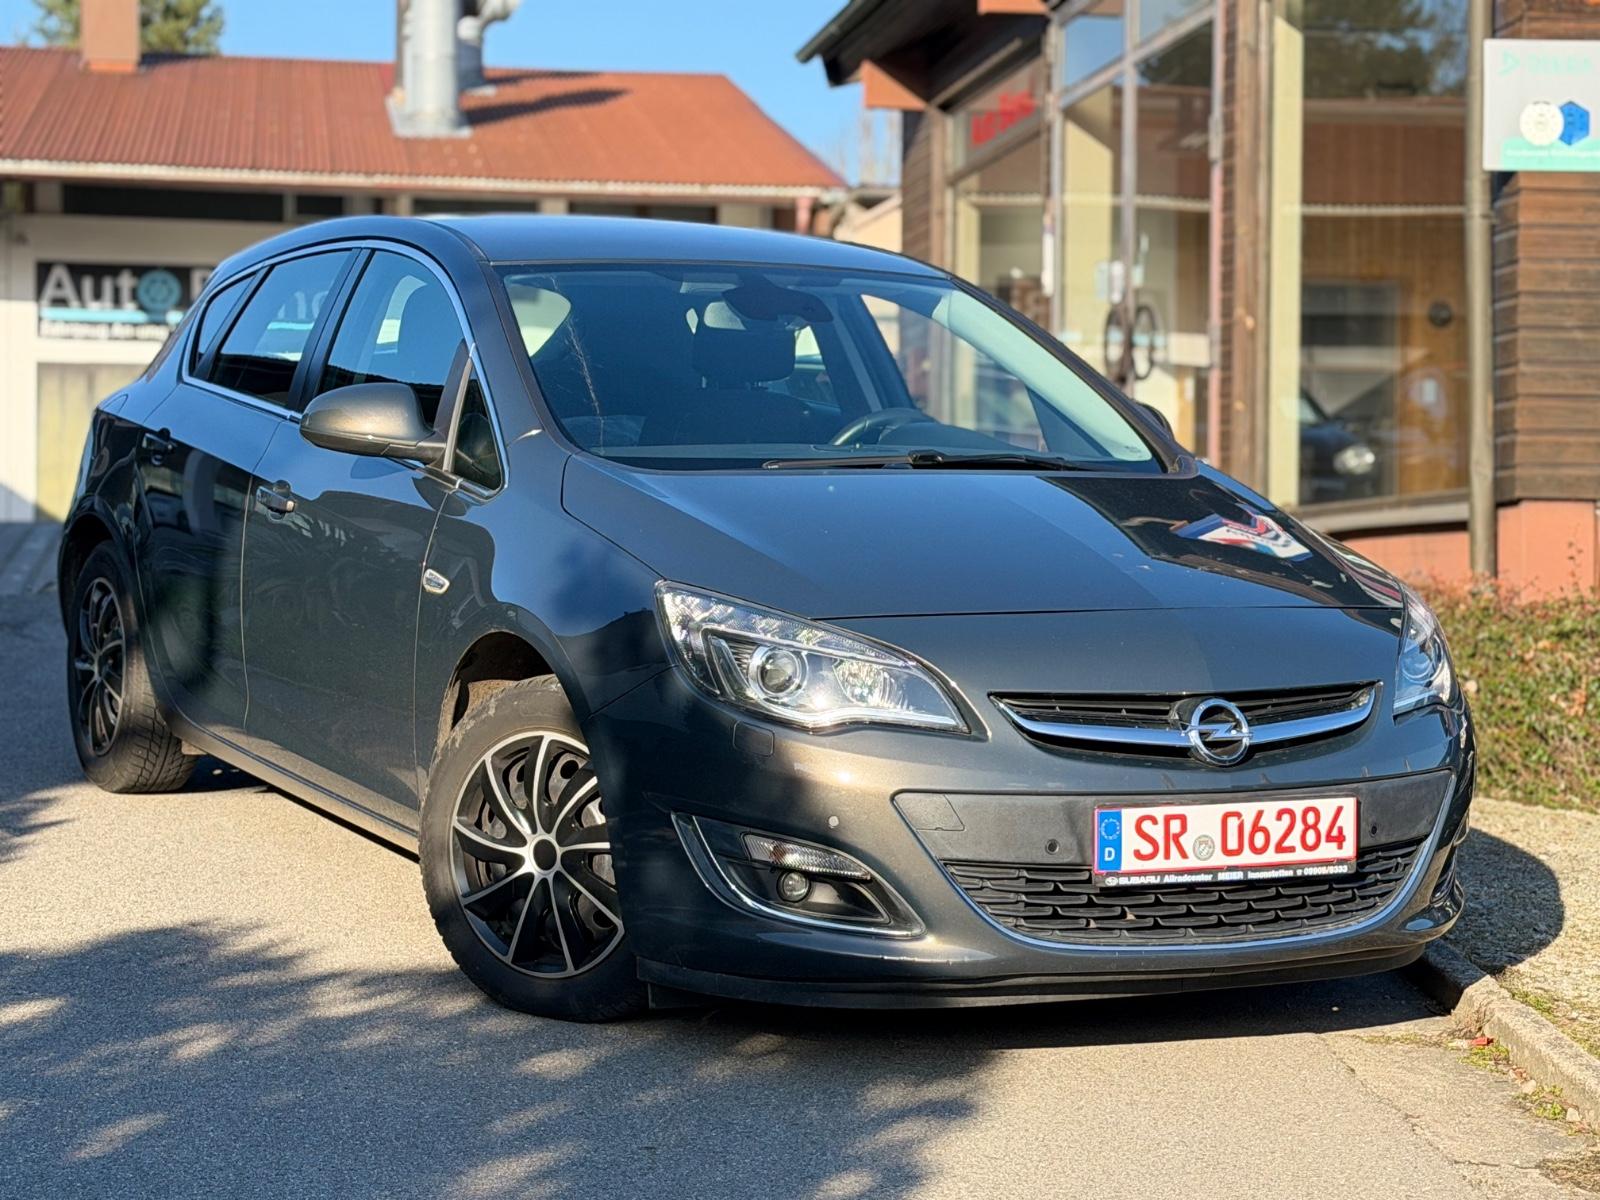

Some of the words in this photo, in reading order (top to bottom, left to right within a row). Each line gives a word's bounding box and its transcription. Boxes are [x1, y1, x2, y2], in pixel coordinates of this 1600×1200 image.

[1133, 813, 1189, 861] SR
[1221, 805, 1346, 857] 06284
[1104, 847, 1116, 862] D
[1118, 875, 1161, 886] SUBARU
